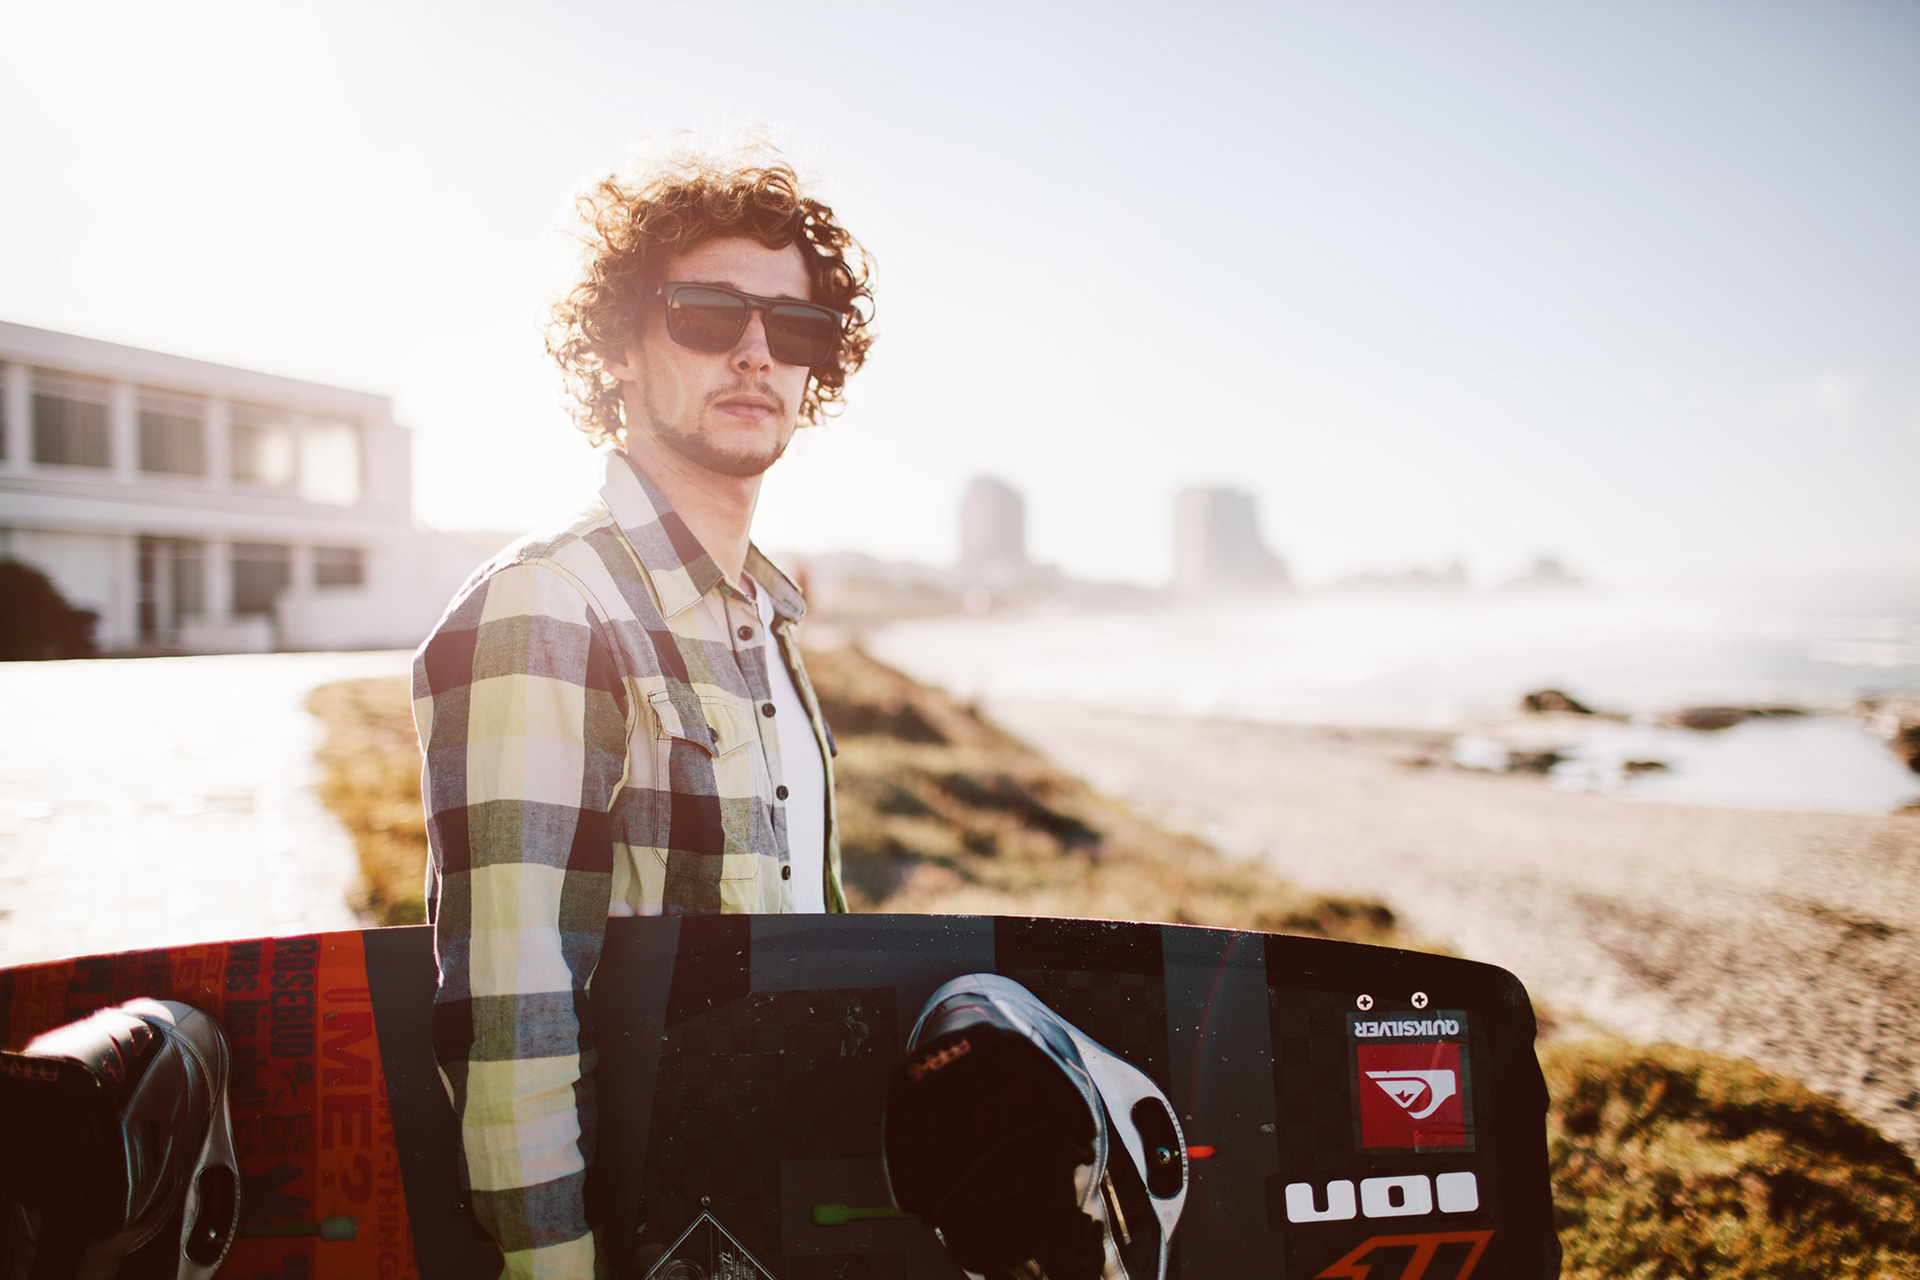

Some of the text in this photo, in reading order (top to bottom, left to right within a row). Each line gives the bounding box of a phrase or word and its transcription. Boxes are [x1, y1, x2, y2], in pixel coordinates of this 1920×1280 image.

[225, 940, 263, 992] was
[269, 938, 318, 1058] ROSEBUD
[1354, 1019, 1460, 1038] QUIKSILVER
